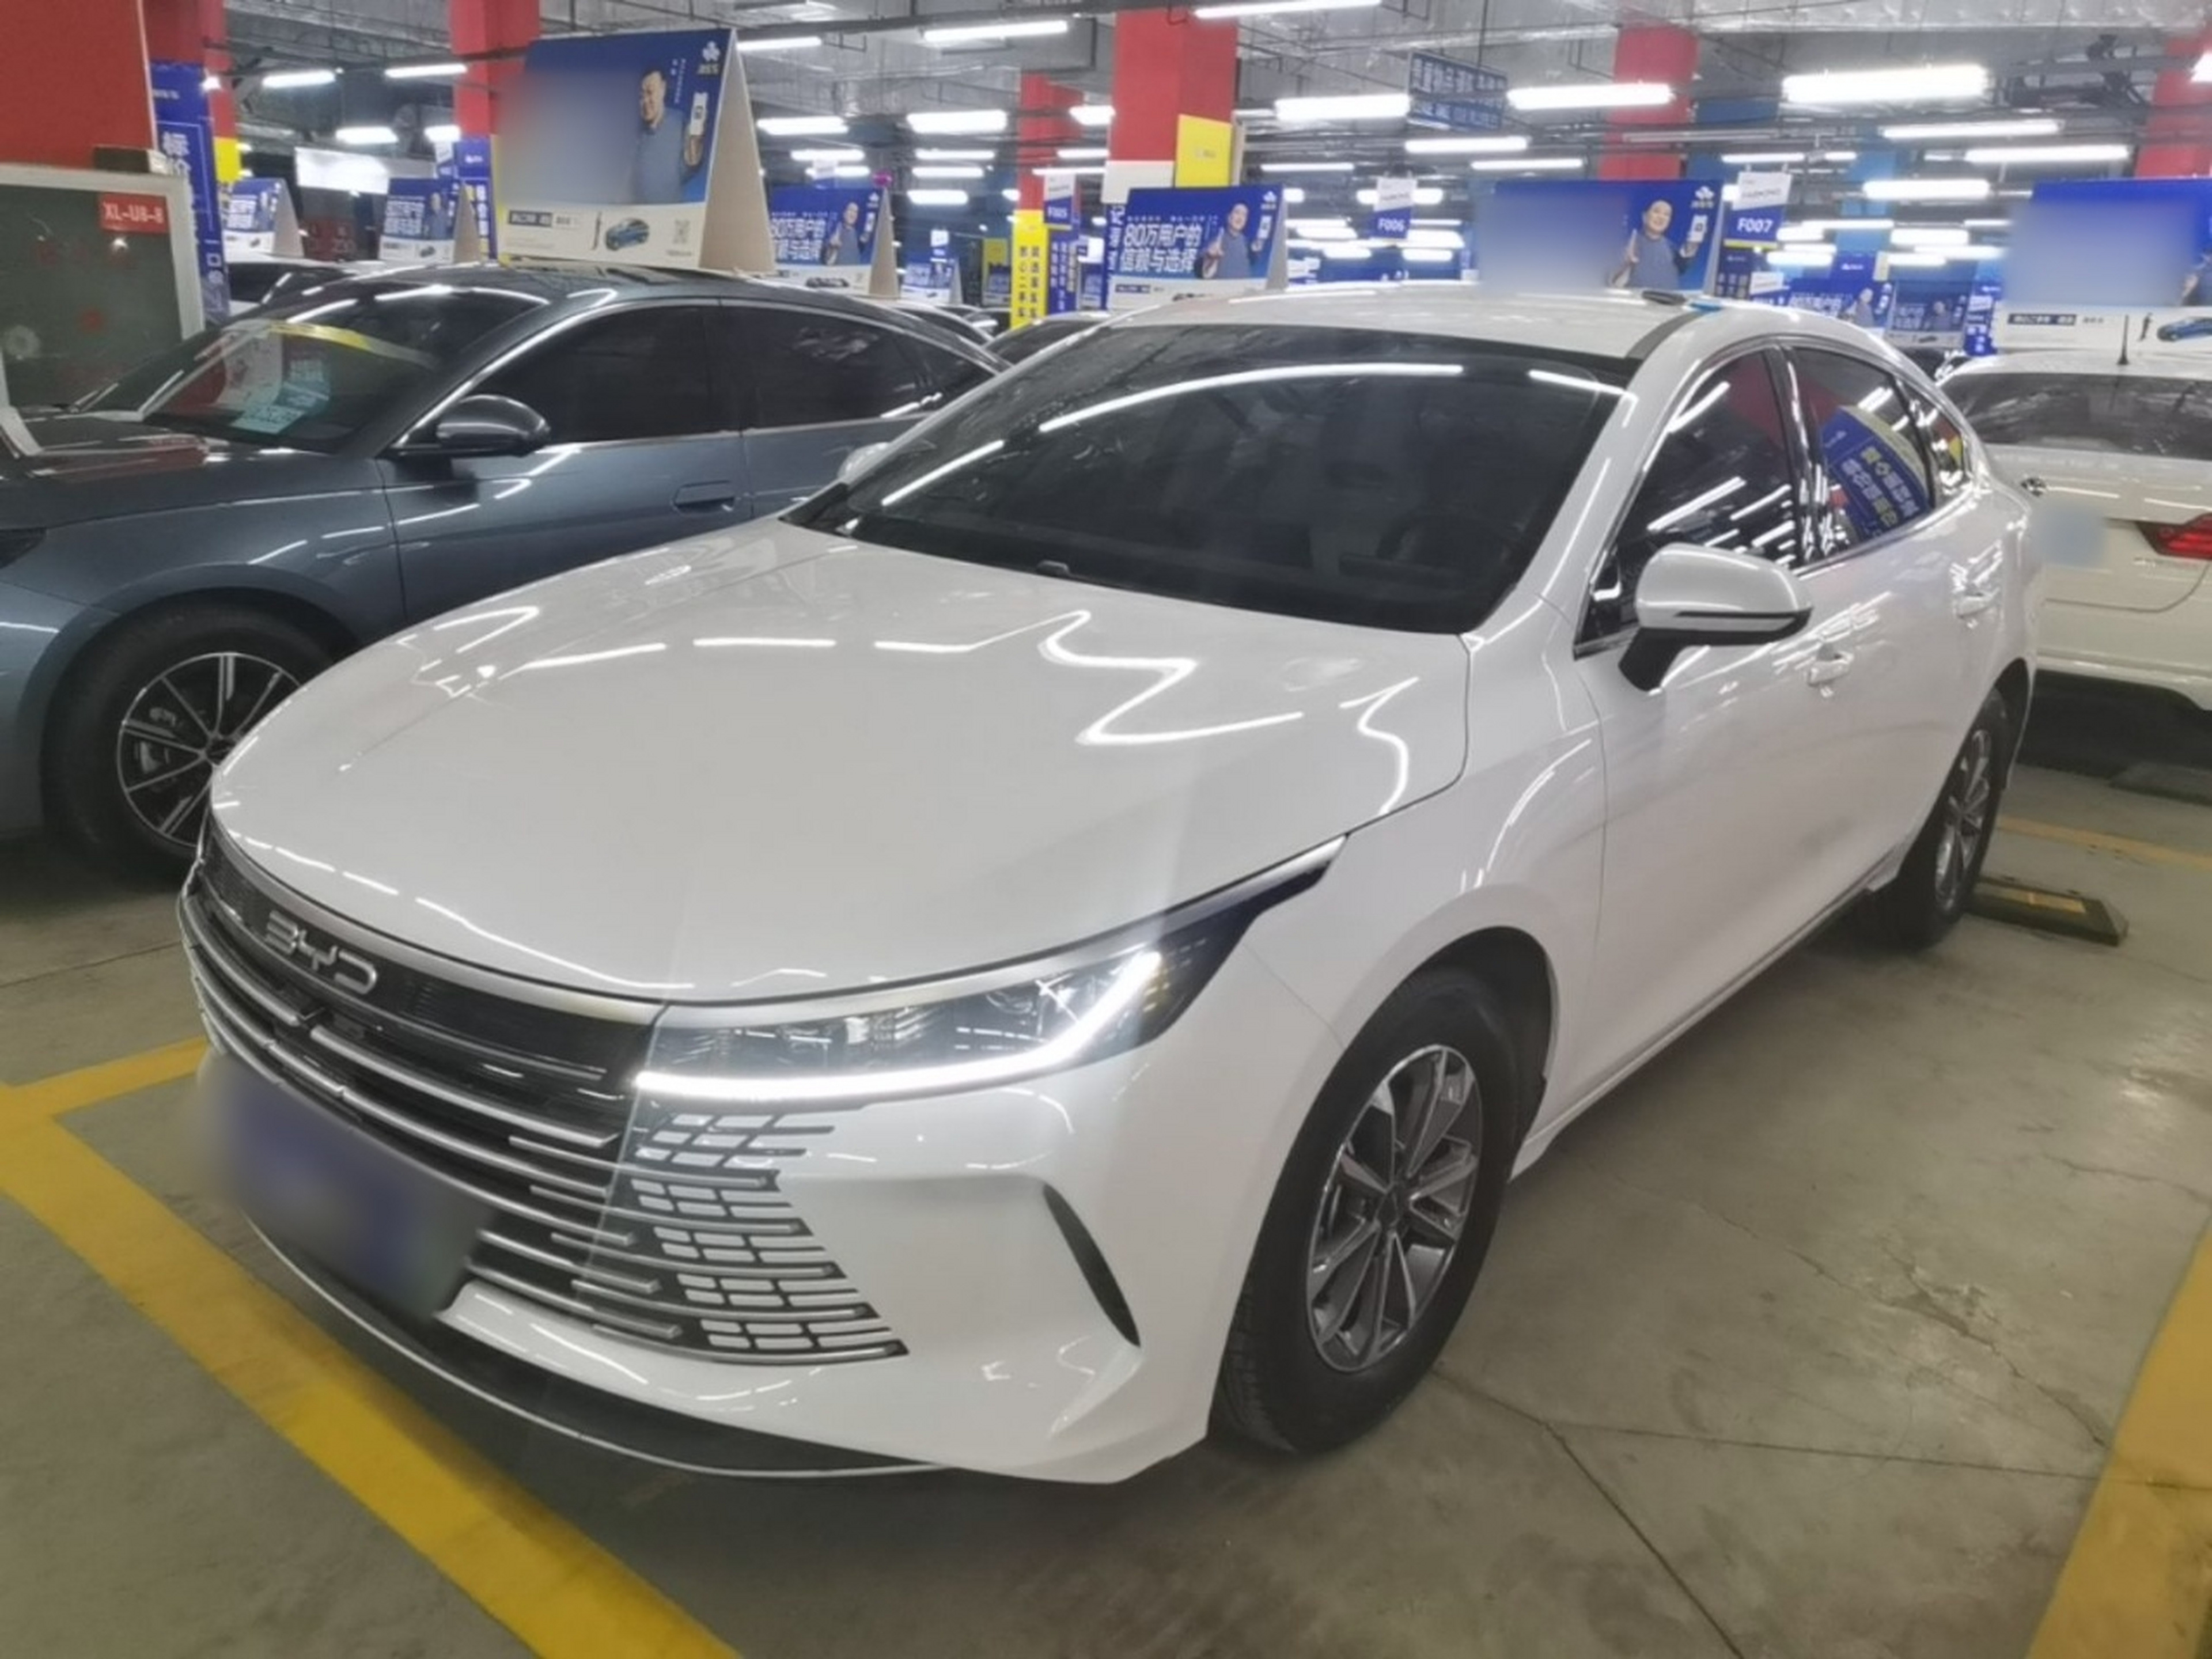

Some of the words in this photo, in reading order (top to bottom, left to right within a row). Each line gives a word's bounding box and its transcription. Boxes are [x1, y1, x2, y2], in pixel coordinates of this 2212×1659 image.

[1123, 222, 1203, 247] 80万用户的
[1377, 217, 1405, 232] F006
[1737, 218, 1774, 233] F007
[1119, 248, 1198, 273] 信赖与选择
[264, 909, 377, 995] BYD
